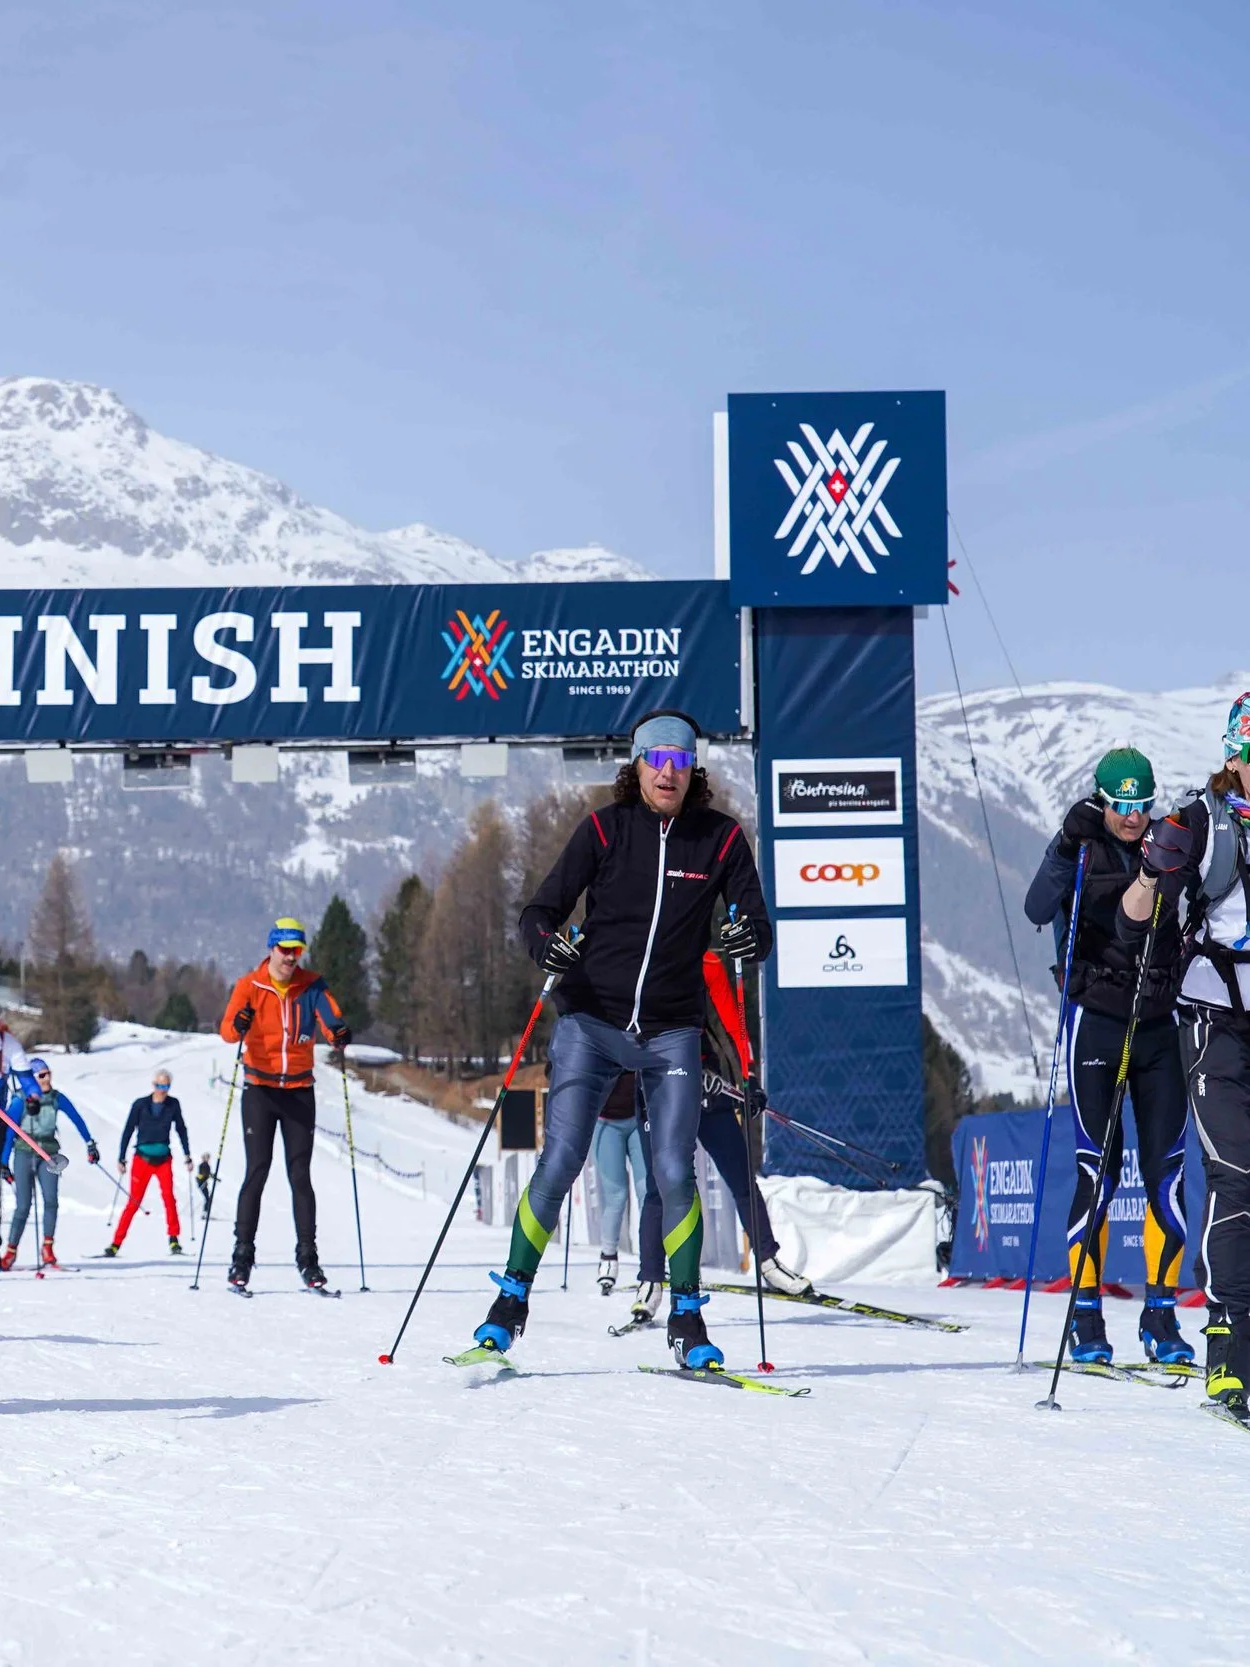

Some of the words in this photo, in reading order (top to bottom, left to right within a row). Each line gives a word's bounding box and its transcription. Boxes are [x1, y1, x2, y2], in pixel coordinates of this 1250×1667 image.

[521, 628, 682, 657] ENGADIN
[521, 659, 680, 679] SKIMARATHON
[568, 685, 603, 696] SINCE
[605, 685, 631, 695] 1969
[790, 779, 866, 799] Pontresina
[799, 864, 880, 887] coop
[822, 960, 864, 973] odlo
